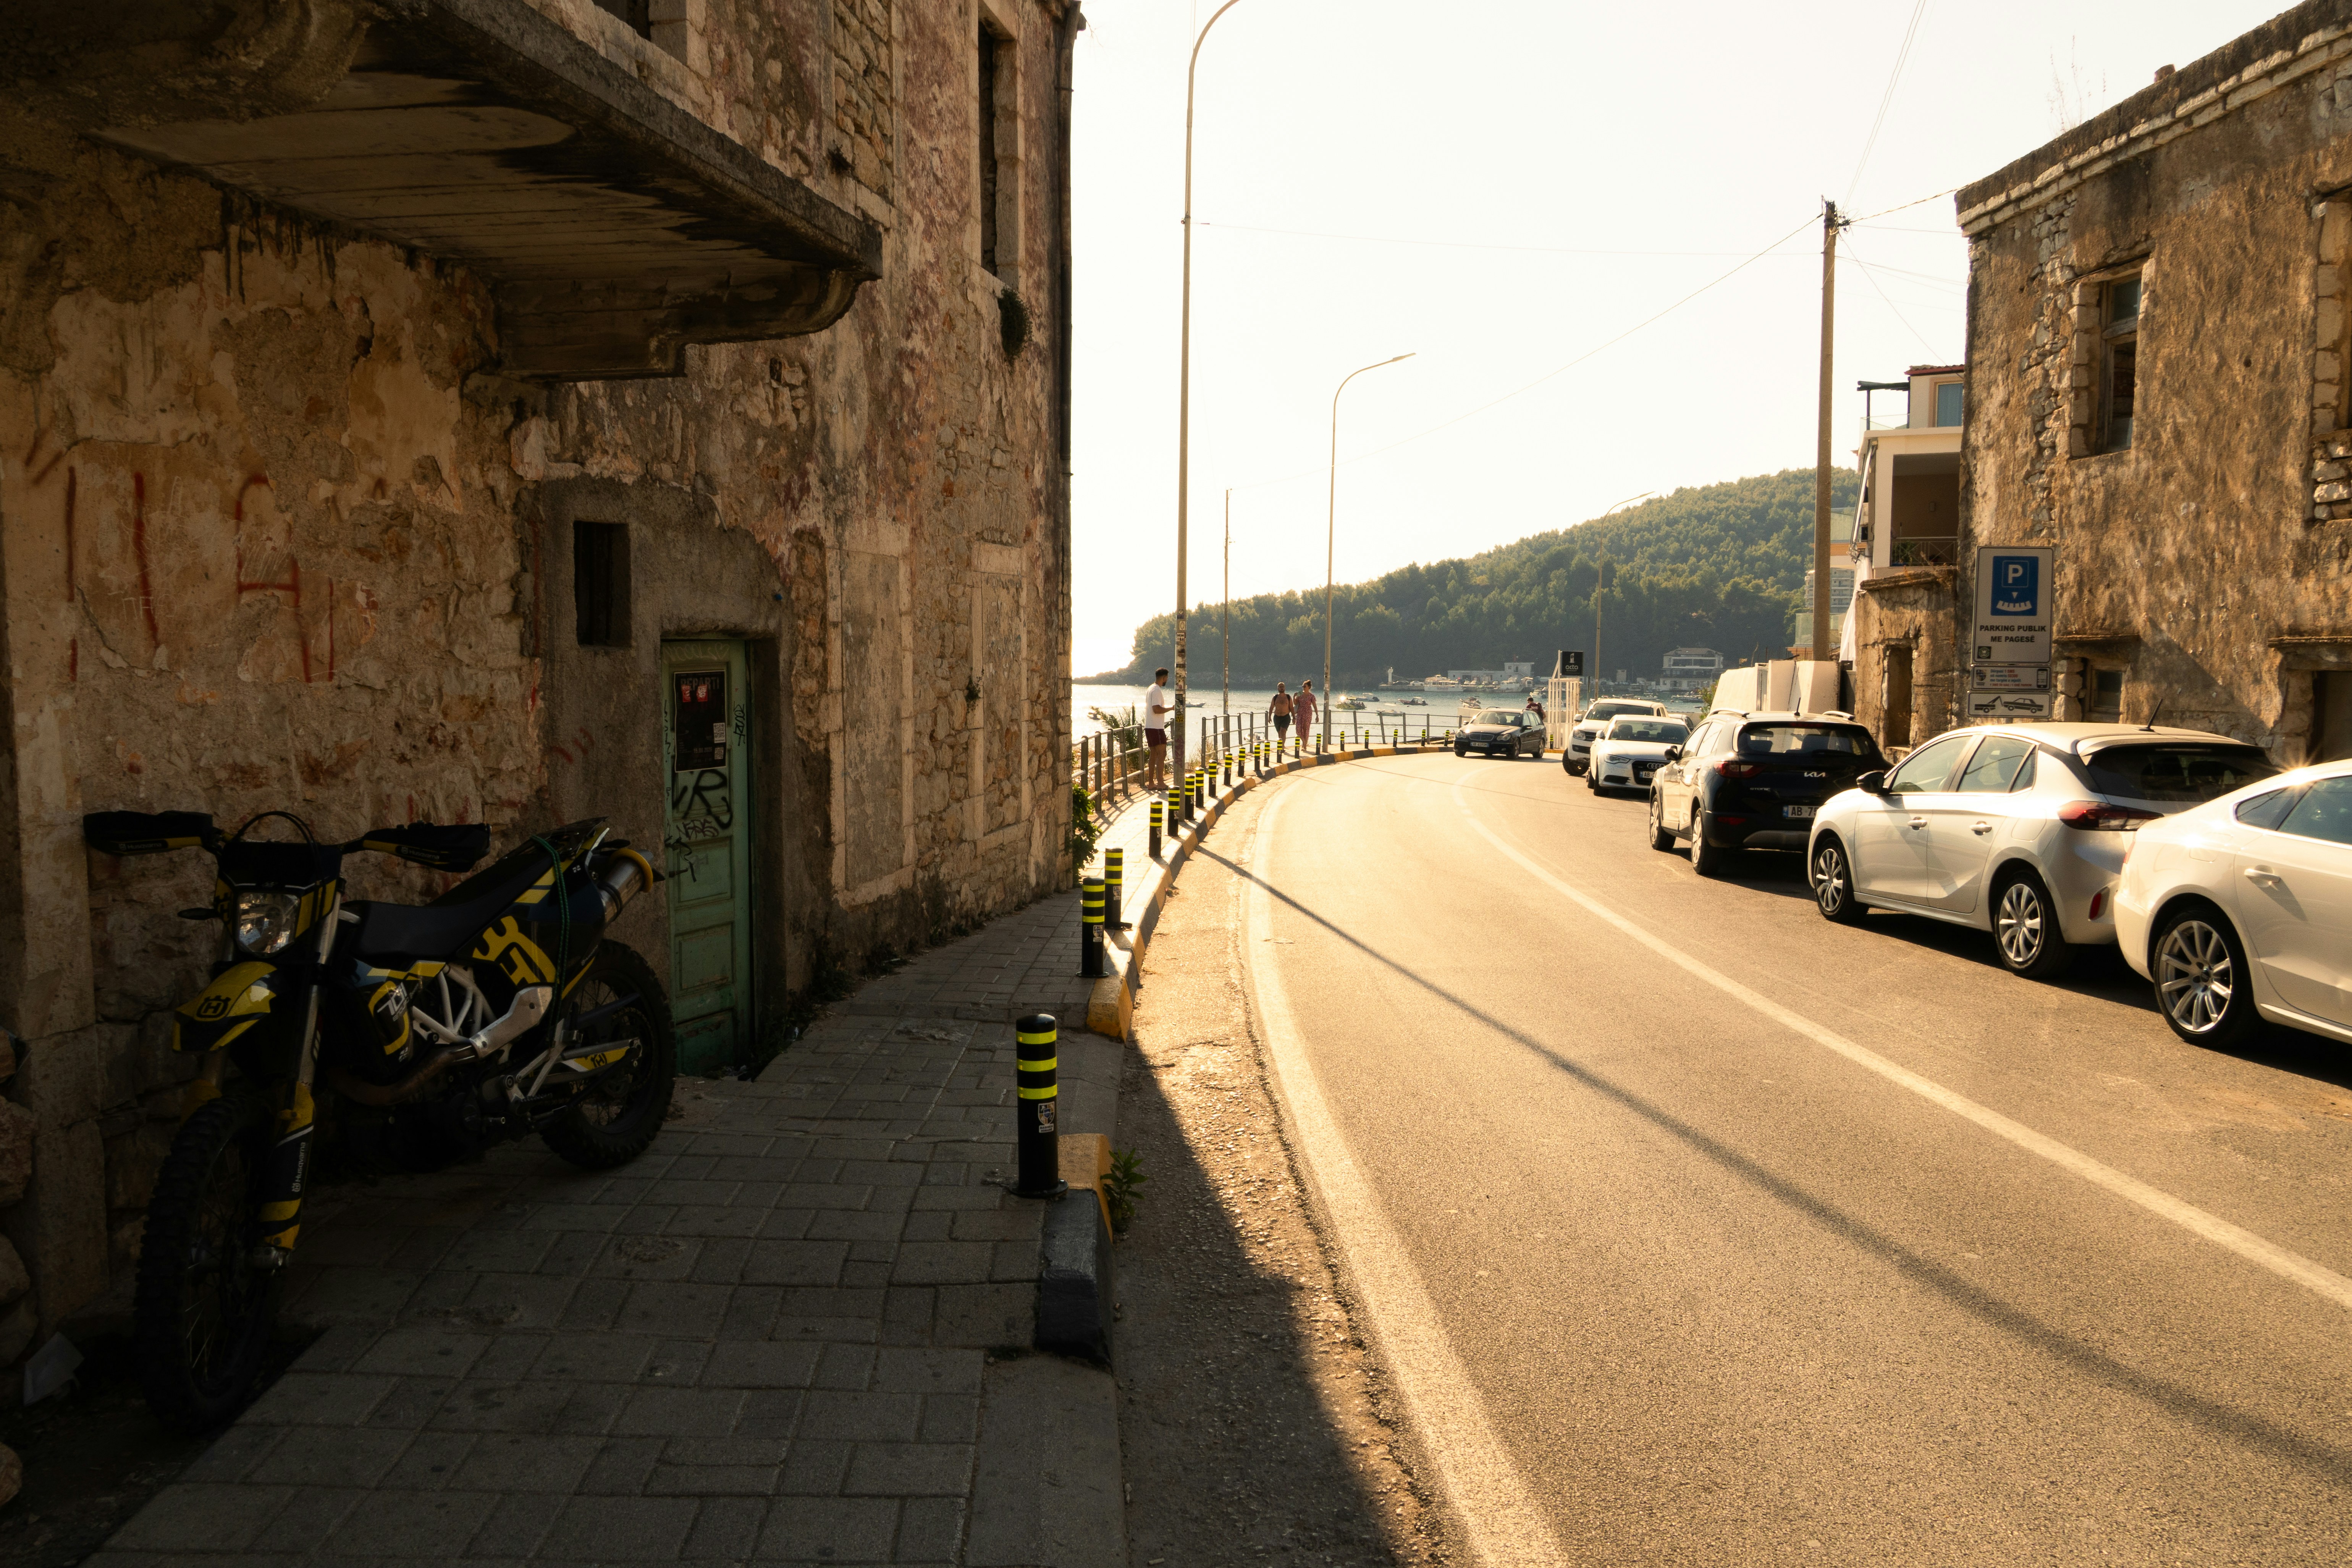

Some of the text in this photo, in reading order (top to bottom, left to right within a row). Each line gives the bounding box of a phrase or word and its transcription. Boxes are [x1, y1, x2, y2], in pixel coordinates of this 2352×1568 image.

[2008, 564, 2023, 584] P
[1791, 807, 1802, 816] AB
[295, 1142, 306, 1182] Husqvarna
